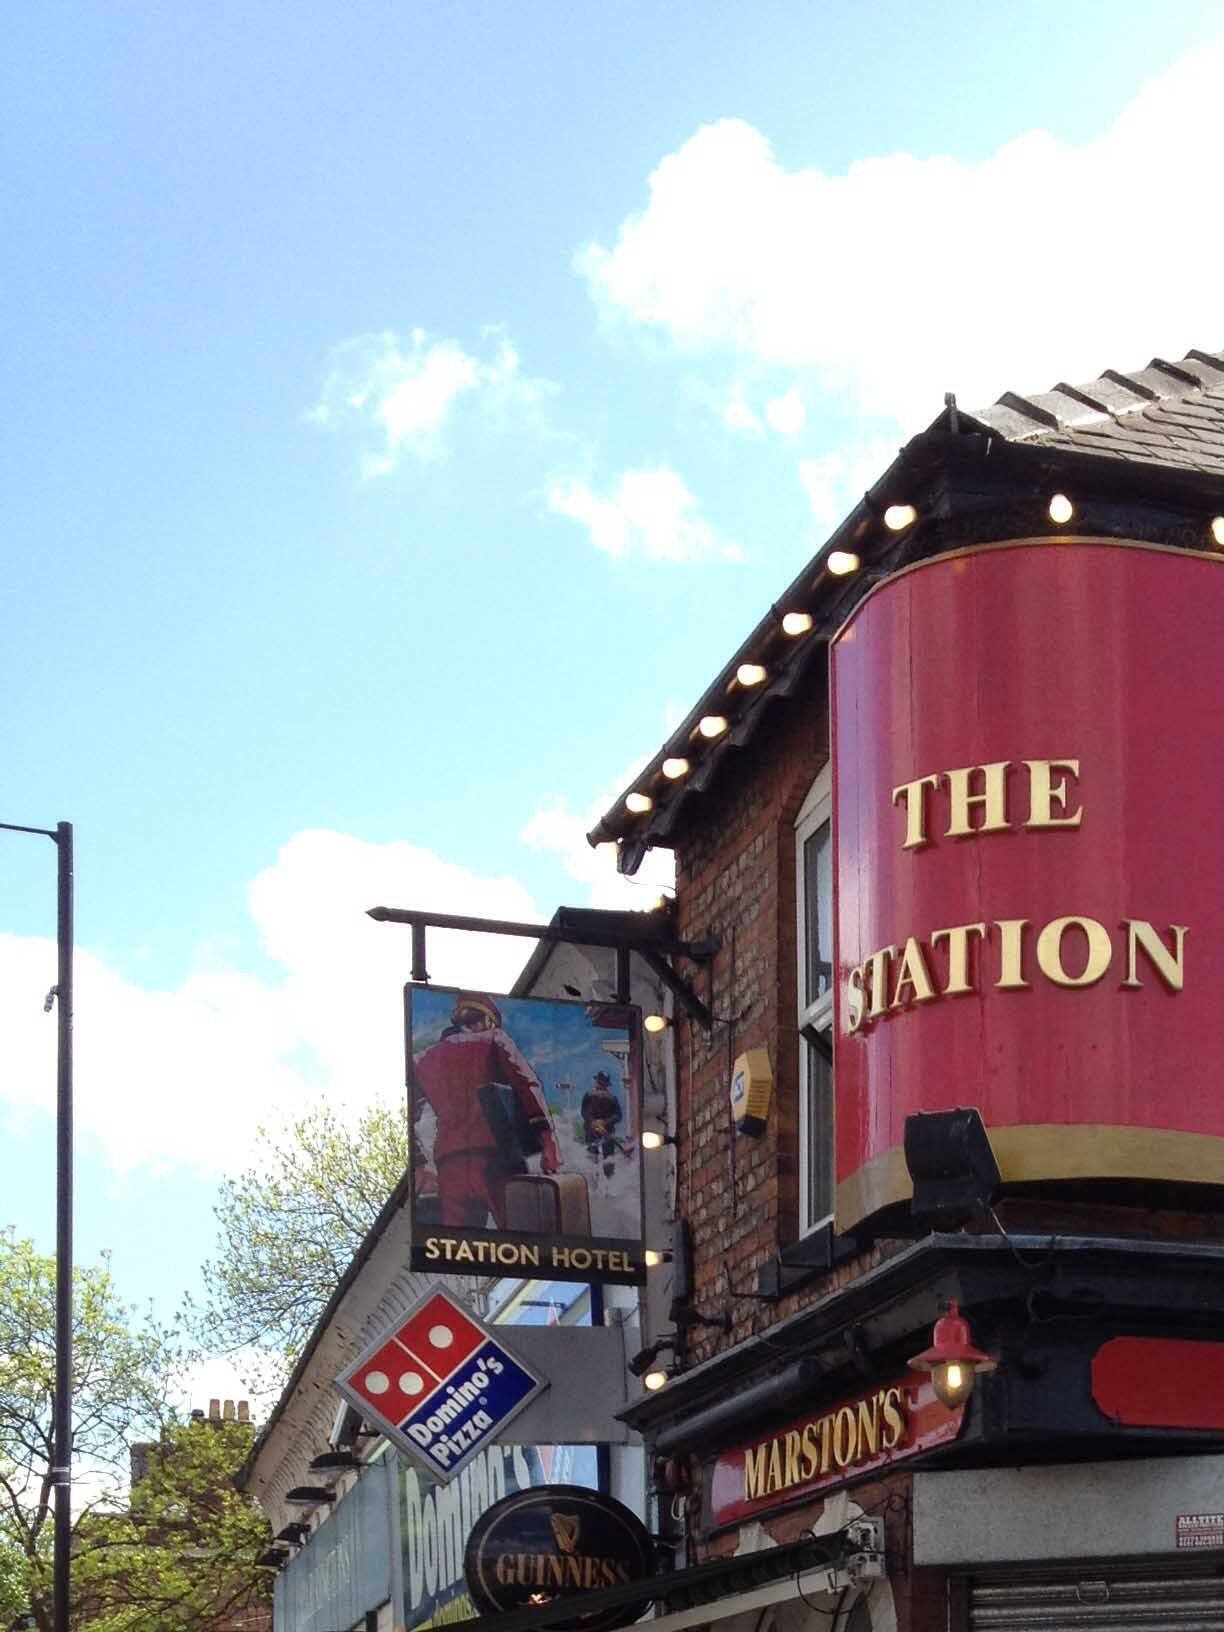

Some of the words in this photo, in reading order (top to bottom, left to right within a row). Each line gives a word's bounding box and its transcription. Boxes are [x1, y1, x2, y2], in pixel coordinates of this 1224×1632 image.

[892, 759, 1084, 850] THE
[846, 915, 1191, 1034] STATION
[425, 1237, 540, 1267] STATION
[552, 1246, 636, 1273] HOTEL
[407, 1356, 505, 1448] Domino's
[429, 1409, 495, 1467] Pizza
[744, 1387, 902, 1502] MARSTON'S
[496, 1552, 634, 1590] GUINNESS
